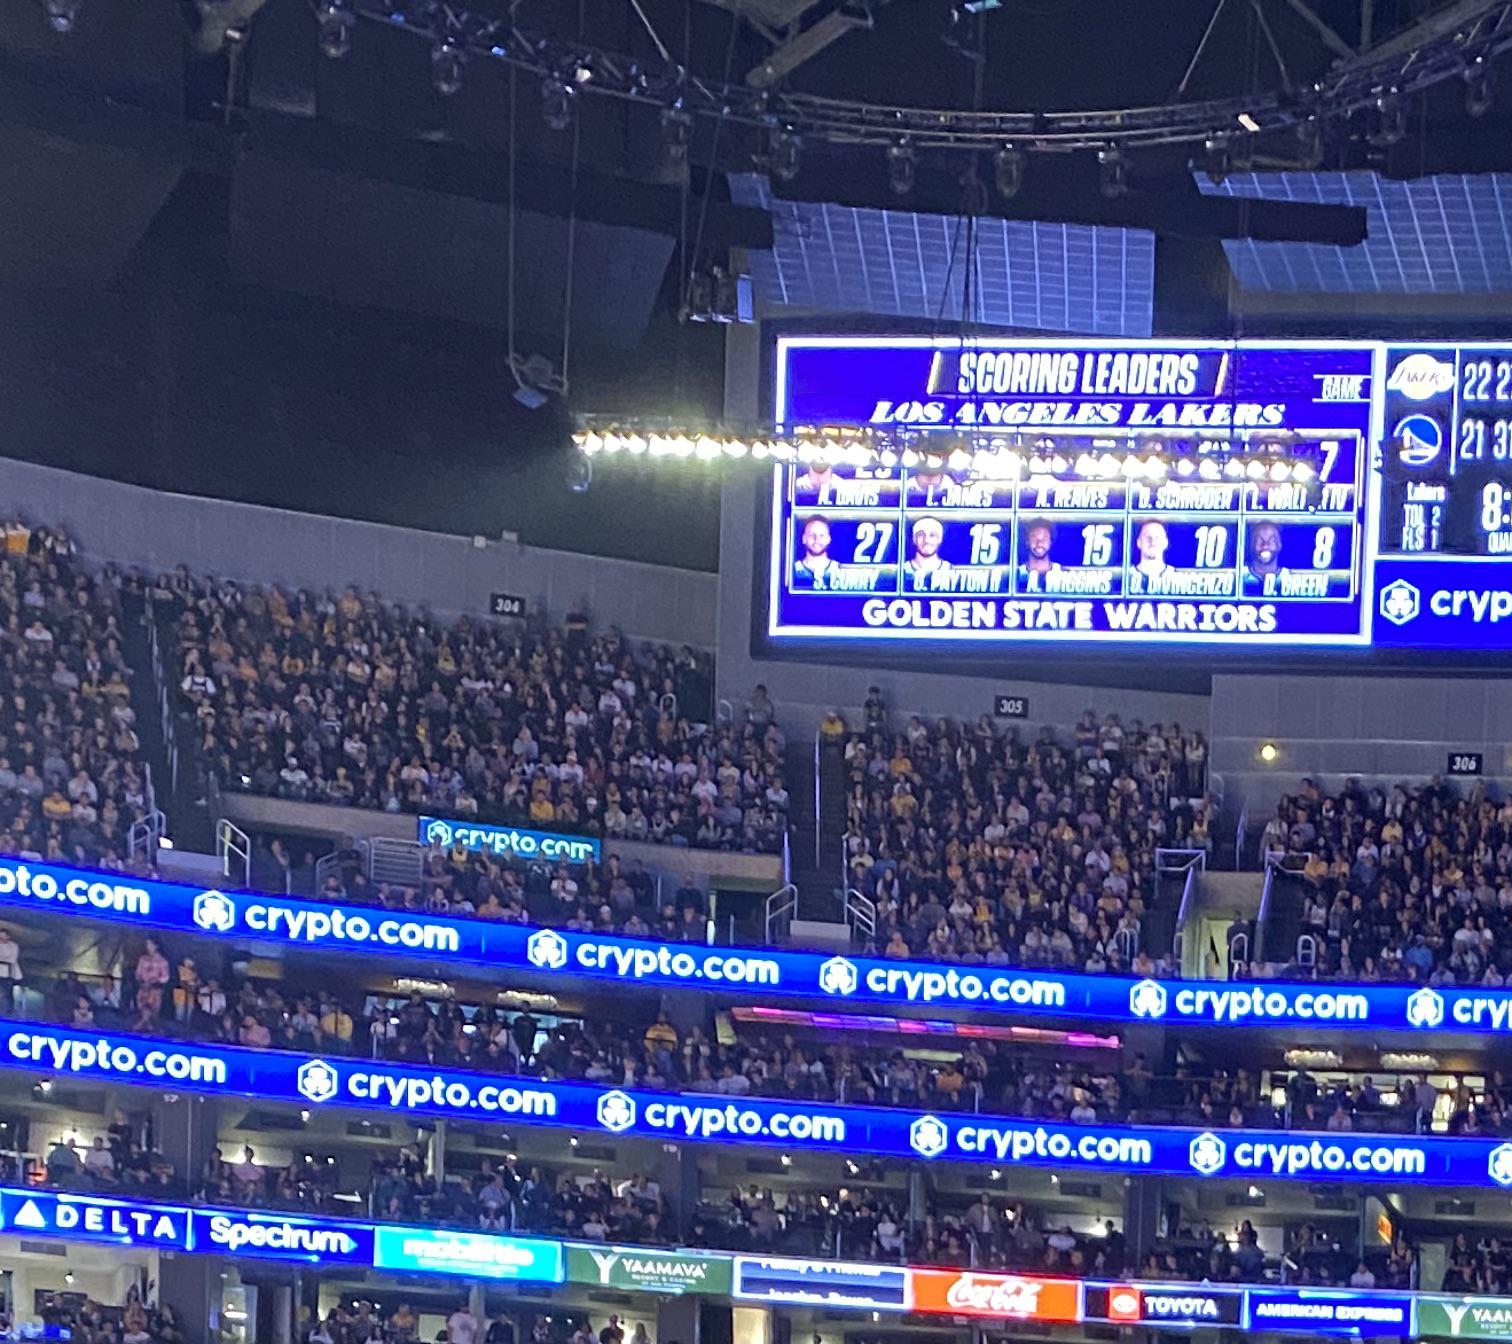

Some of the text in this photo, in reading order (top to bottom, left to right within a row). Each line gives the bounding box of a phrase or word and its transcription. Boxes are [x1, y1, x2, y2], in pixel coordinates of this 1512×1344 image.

[957, 352, 1200, 395] SCORING LEADERS
[1462, 361, 1492, 401] 22
[869, 400, 1287, 426] LOS ANGELES LAKERS
[1459, 419, 1485, 460] 21
[1318, 440, 1340, 483] 7
[853, 522, 893, 563] 27
[969, 523, 1001, 565] 15
[1081, 524, 1115, 566] 15
[1194, 525, 1228, 567] 10
[1311, 526, 1335, 569] 8
[495, 597, 521, 615] 304
[862, 599, 1277, 632] GOLDEN STATE WARRIORS
[999, 698, 1024, 715] 305
[1452, 756, 1477, 772] 306
[454, 826, 594, 860] crypto.com
[244, 904, 459, 952] crypto.com
[576, 945, 779, 985] crypto.com
[866, 961, 1065, 1004] crypto.com
[1175, 987, 1368, 1020] crypto.com
[8, 1029, 227, 1083] crypto.com
[347, 1070, 556, 1116] crypto.com
[644, 1100, 846, 1142] crypto.com
[956, 1124, 1152, 1163] crypto.com
[1233, 1138, 1426, 1174] crypto.com
[56, 1204, 177, 1240] DELTA
[209, 1215, 351, 1254] Spectrum
[1144, 1296, 1217, 1316] TOYOTA
